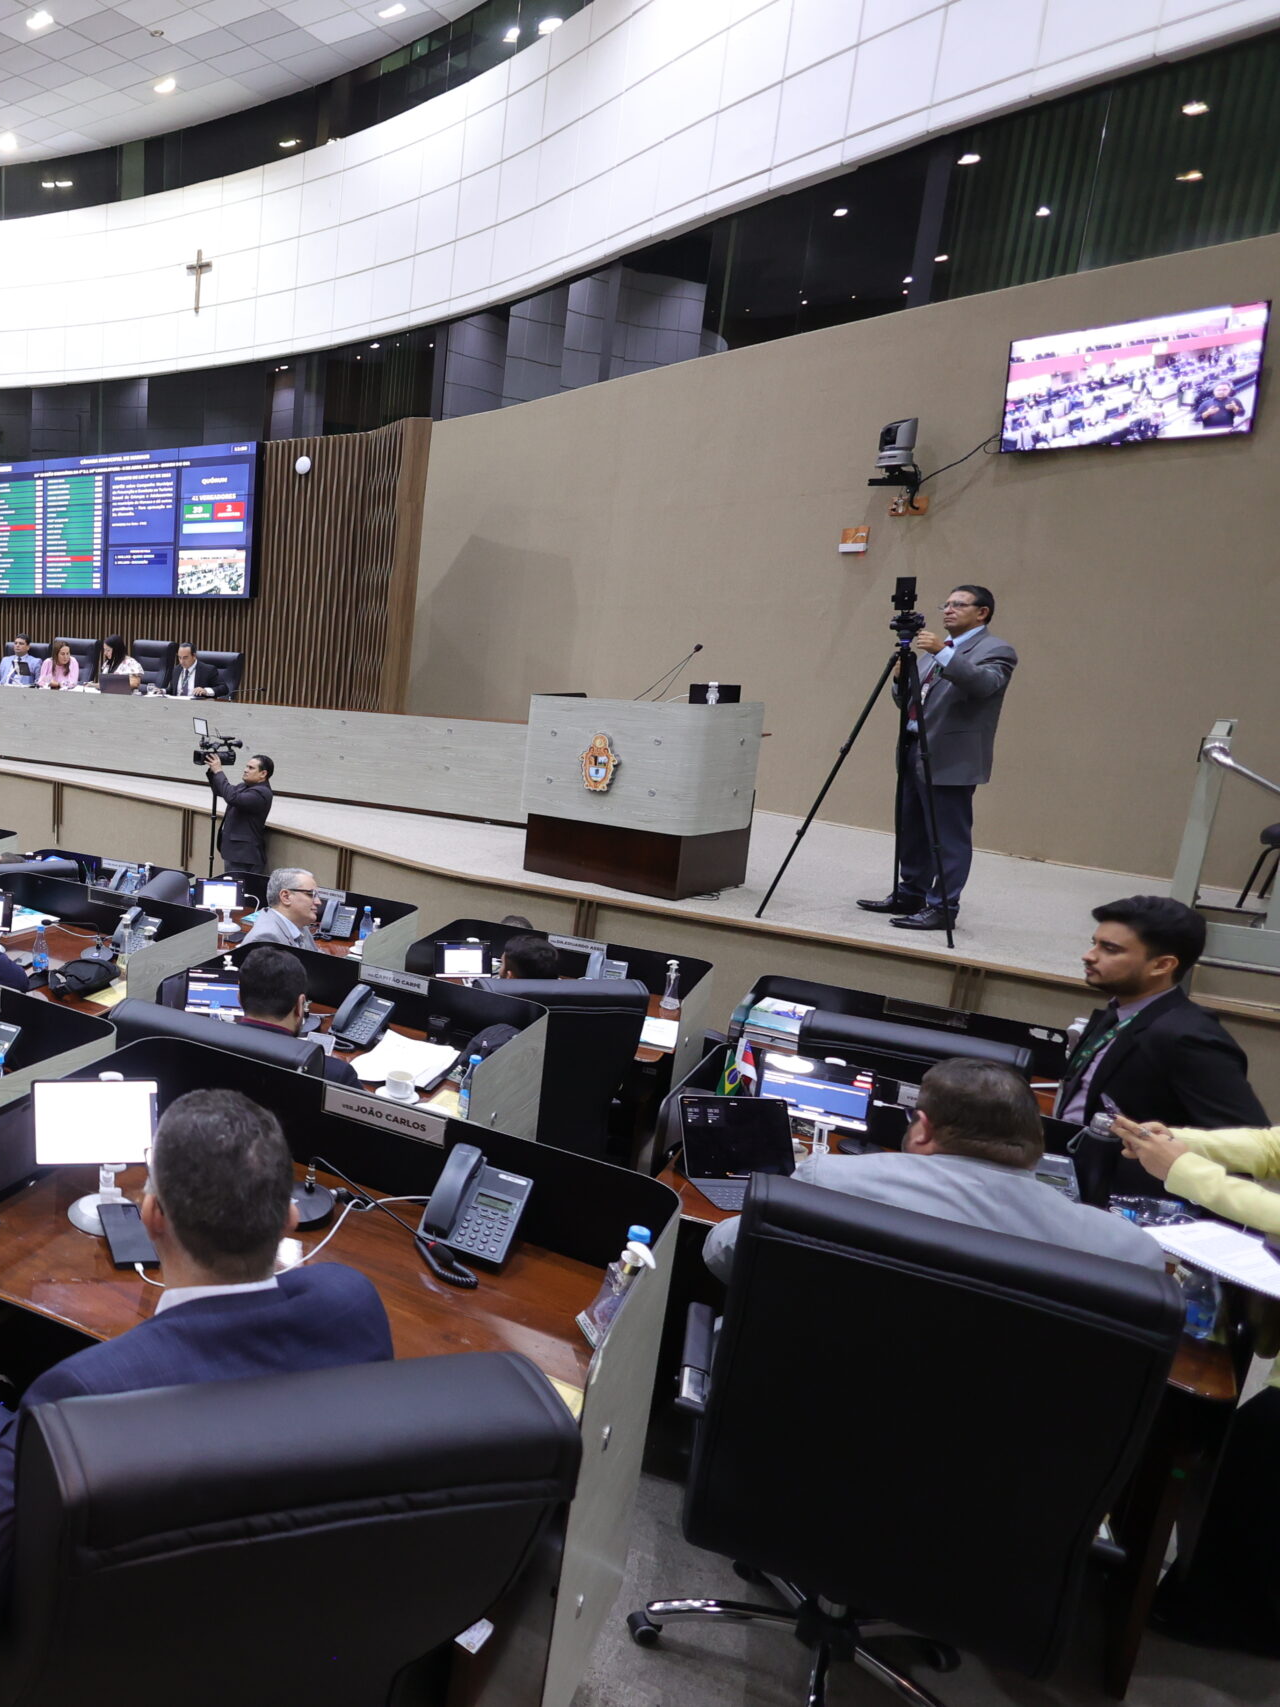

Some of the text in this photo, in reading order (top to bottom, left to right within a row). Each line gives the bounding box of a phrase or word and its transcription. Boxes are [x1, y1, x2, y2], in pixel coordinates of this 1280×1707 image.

[201, 477, 227, 485] QUÓRUM
[199, 493, 236, 501] VEREADORES
[385, 1113, 427, 1132] CARLOS
